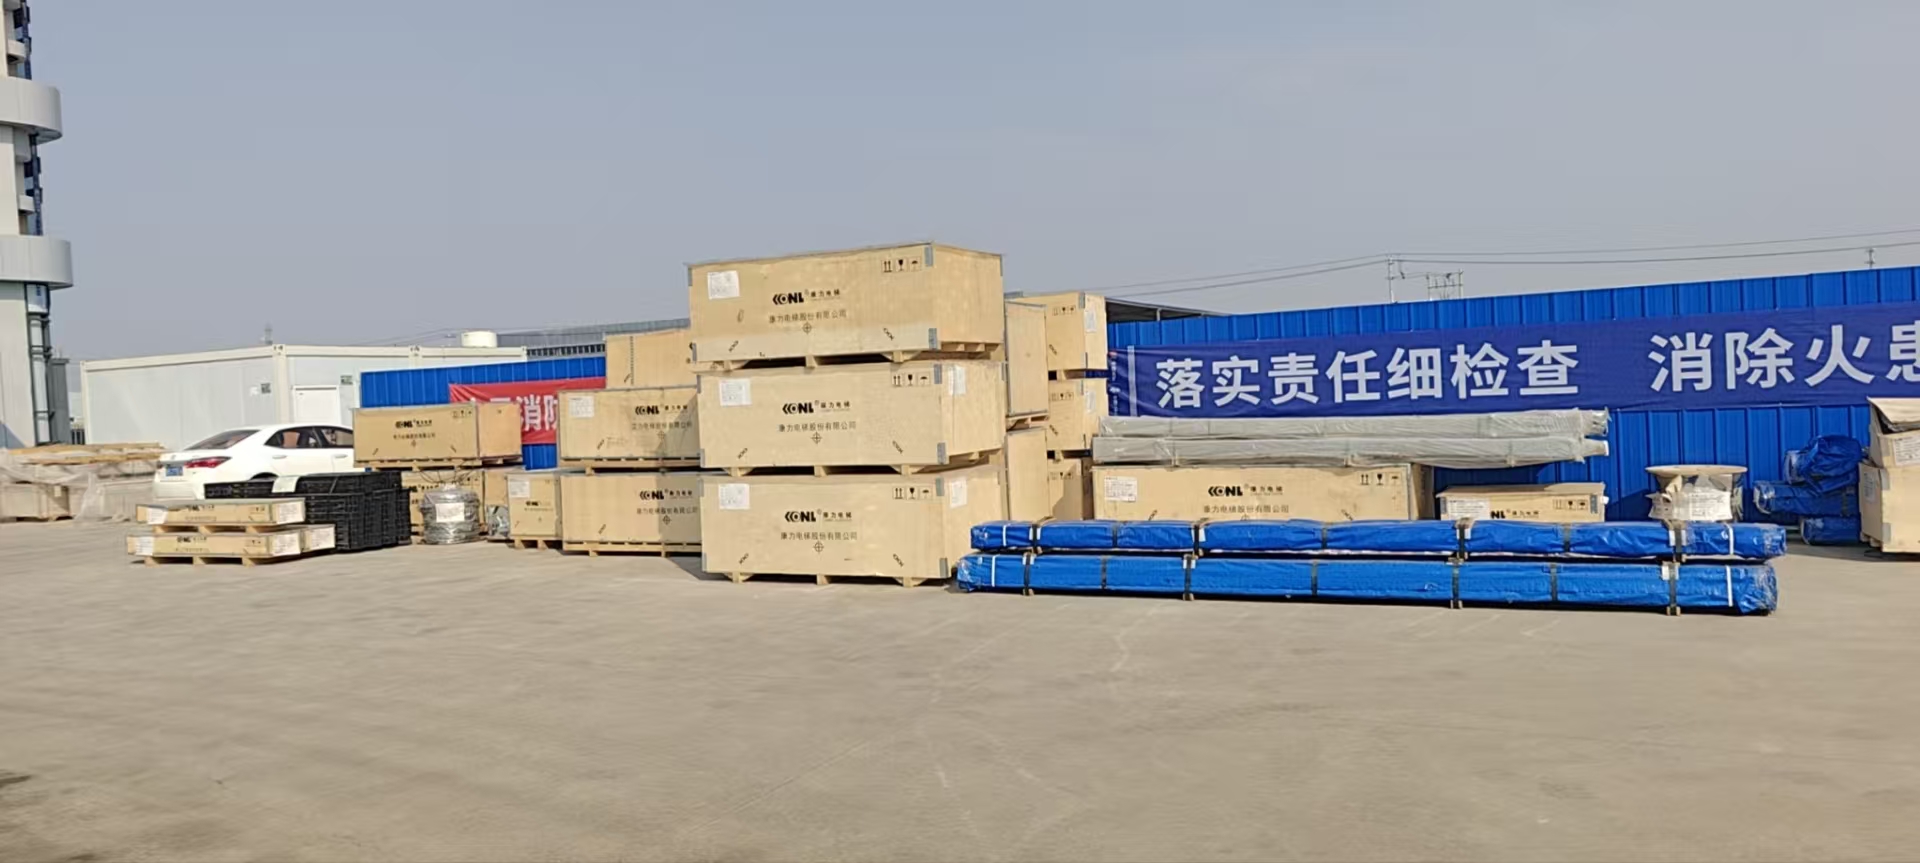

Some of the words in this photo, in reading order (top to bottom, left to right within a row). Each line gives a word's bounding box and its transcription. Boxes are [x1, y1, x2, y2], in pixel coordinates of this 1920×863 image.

[1155, 339, 1579, 409] 落实责任细检查
